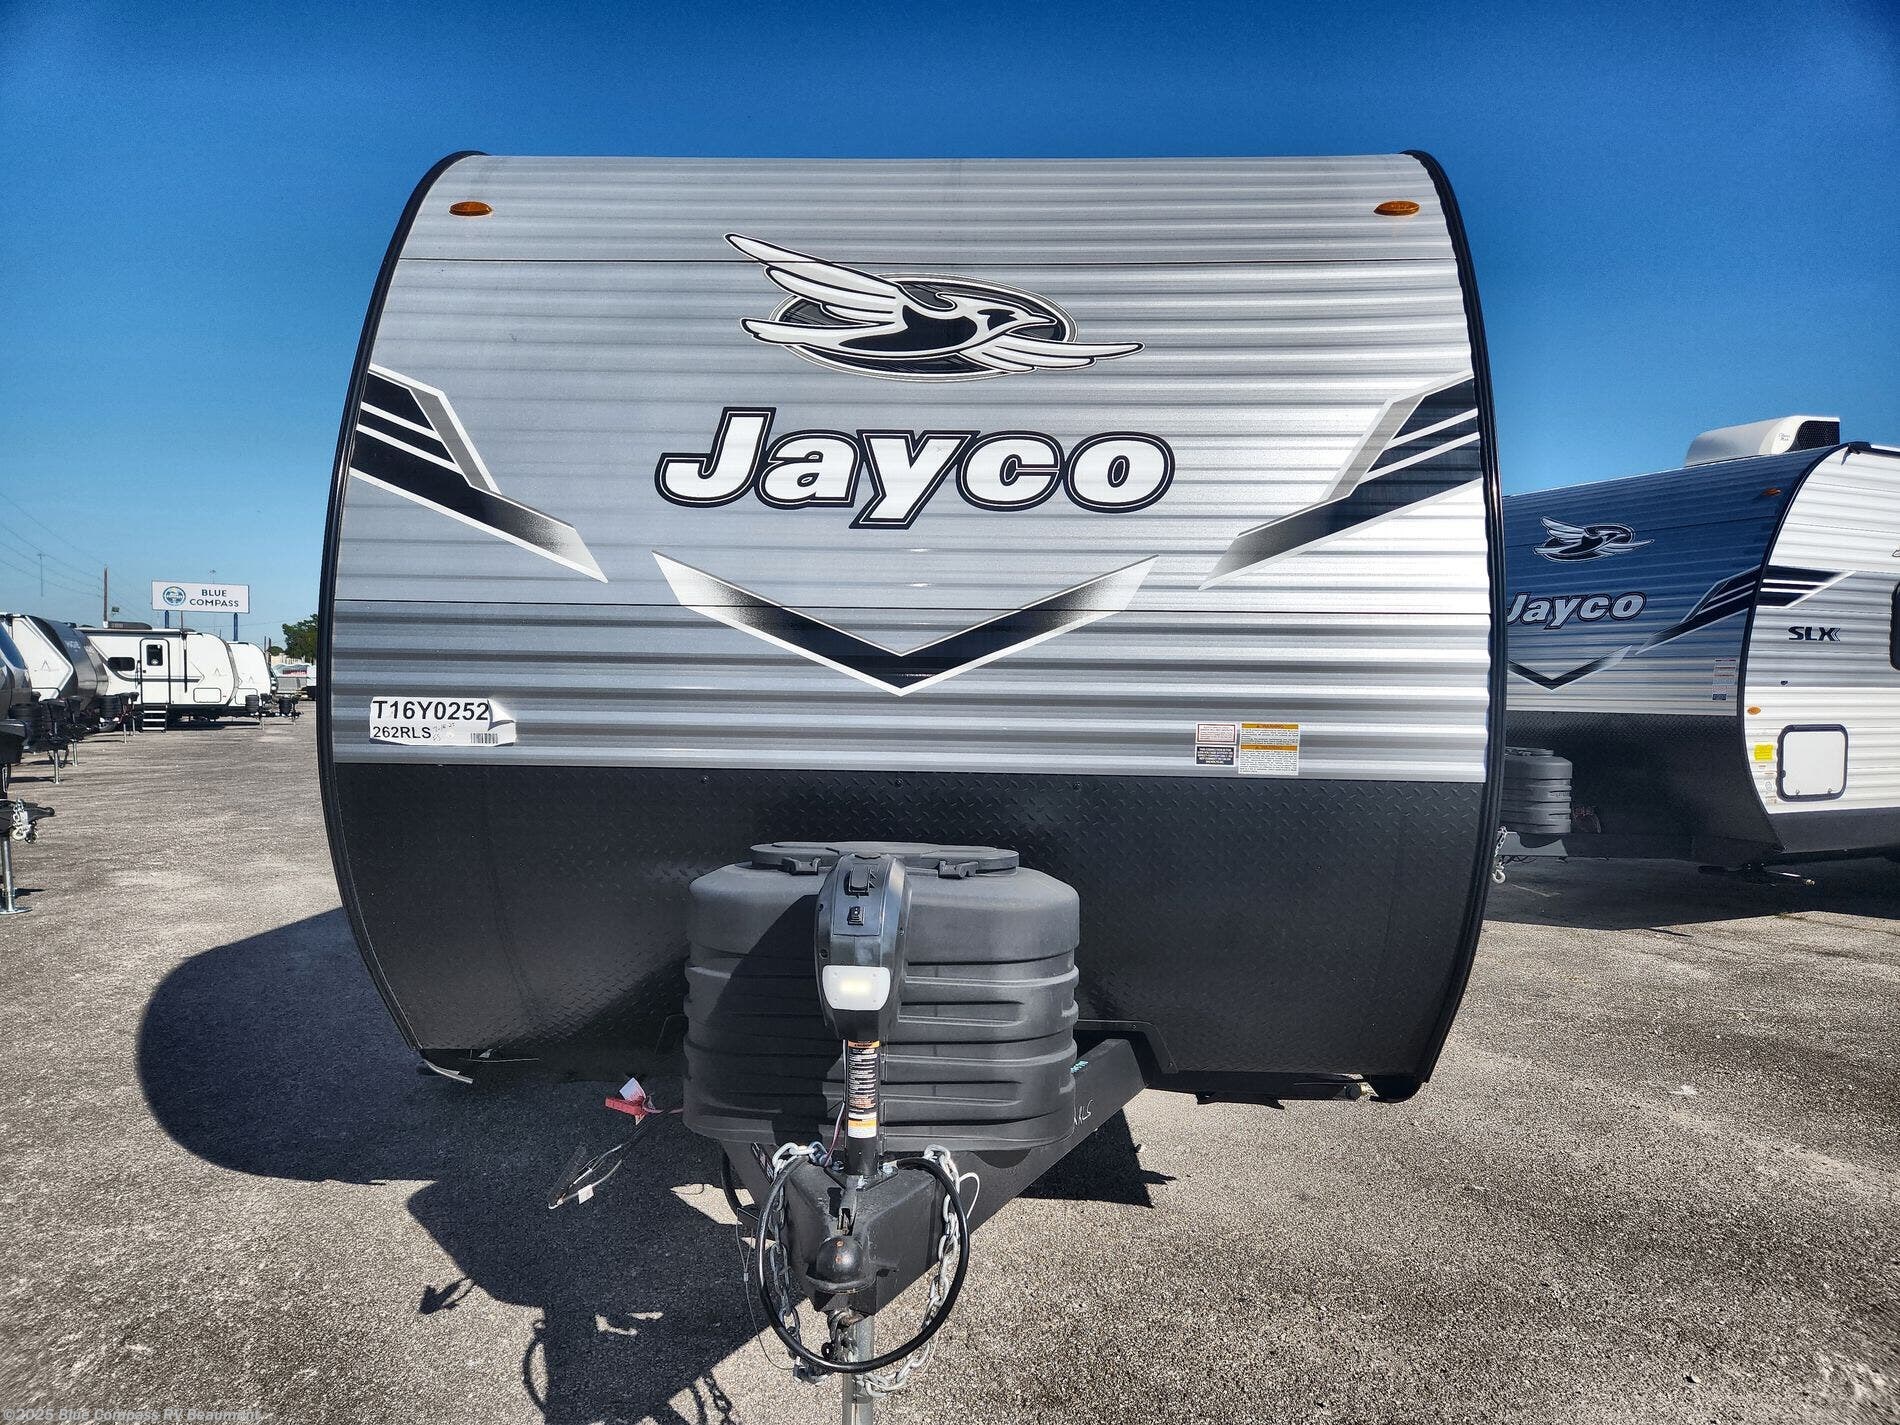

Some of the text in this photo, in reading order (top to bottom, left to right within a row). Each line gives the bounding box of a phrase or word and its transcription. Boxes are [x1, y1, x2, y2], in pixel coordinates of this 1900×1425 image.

[655, 406, 1176, 530] Jayco
[201, 589, 227, 597] BLUE
[189, 598, 239, 607] COMPASS
[1506, 591, 1647, 630] Jayco
[1788, 626, 1840, 642] SLX
[372, 700, 489, 721] T16Y0252
[373, 726, 432, 739] 262RLS
